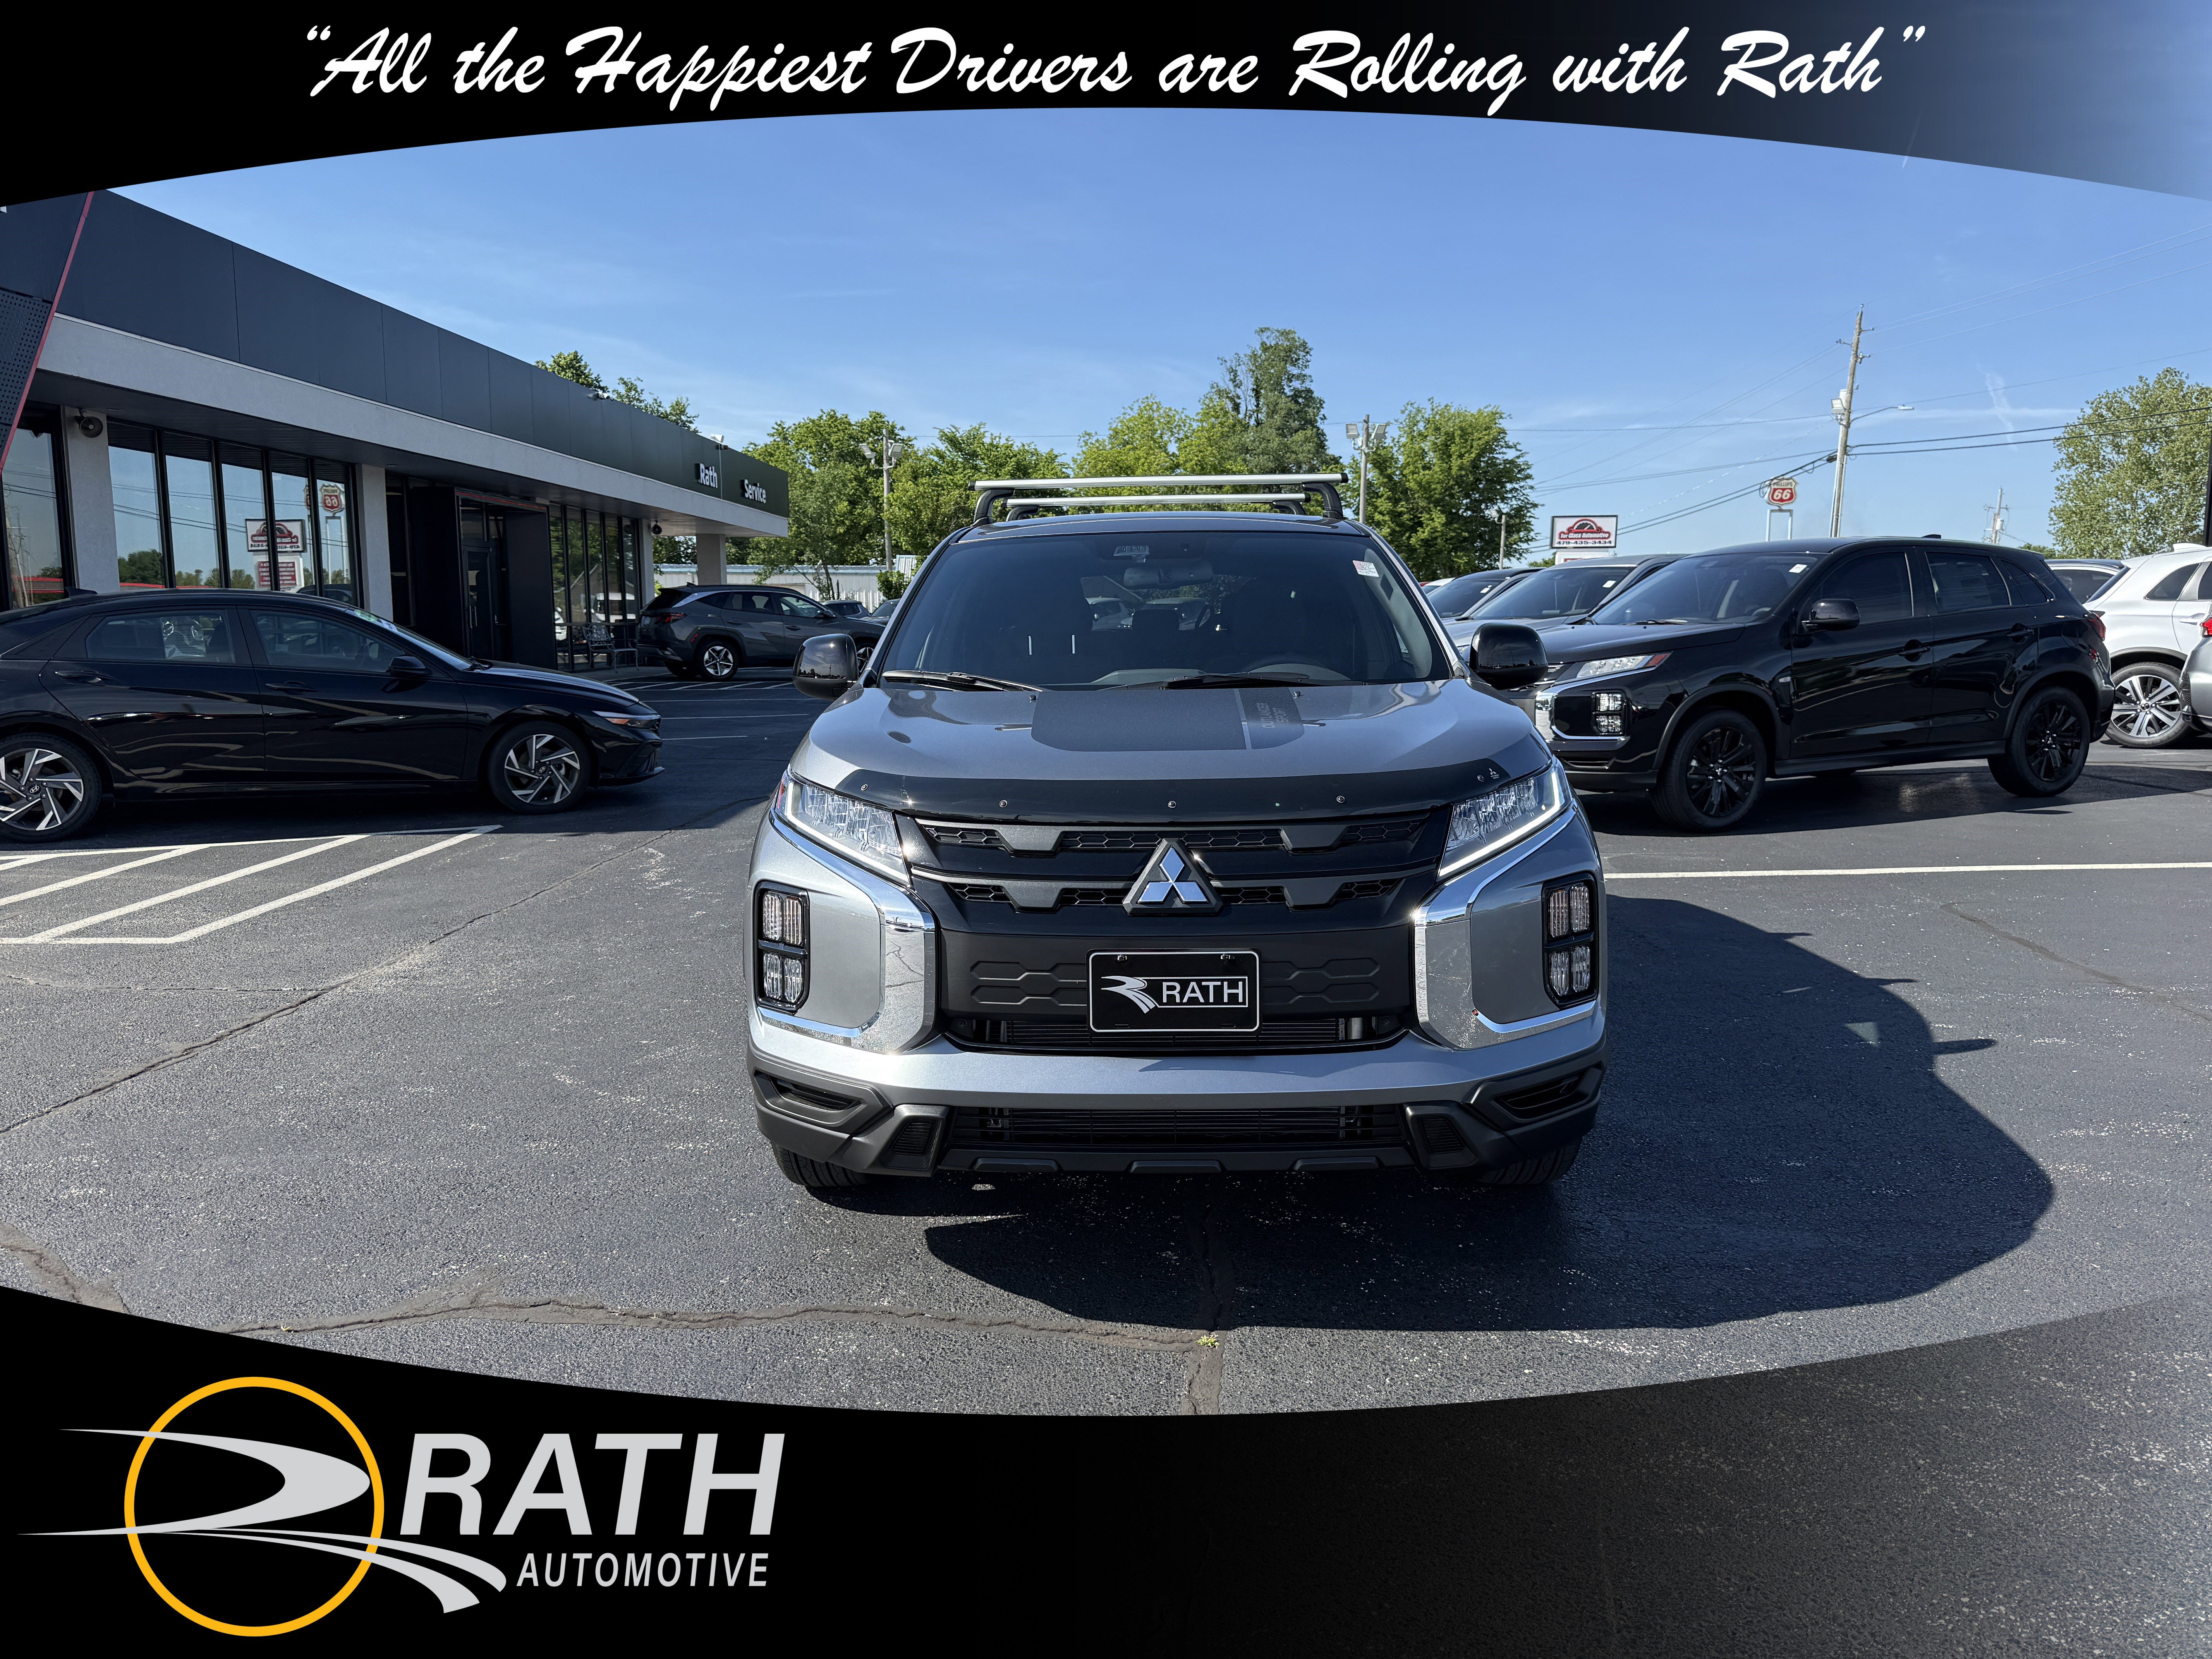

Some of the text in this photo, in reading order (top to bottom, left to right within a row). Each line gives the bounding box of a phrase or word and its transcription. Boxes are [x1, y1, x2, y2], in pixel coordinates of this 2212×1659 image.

[700, 463, 766, 503] Rath Service
[1773, 489, 1791, 500] 66
[1257, 702, 1275, 728] OUTLANDER
[1273, 708, 1289, 723] SPORT
[1163, 981, 1243, 1003] RATH
